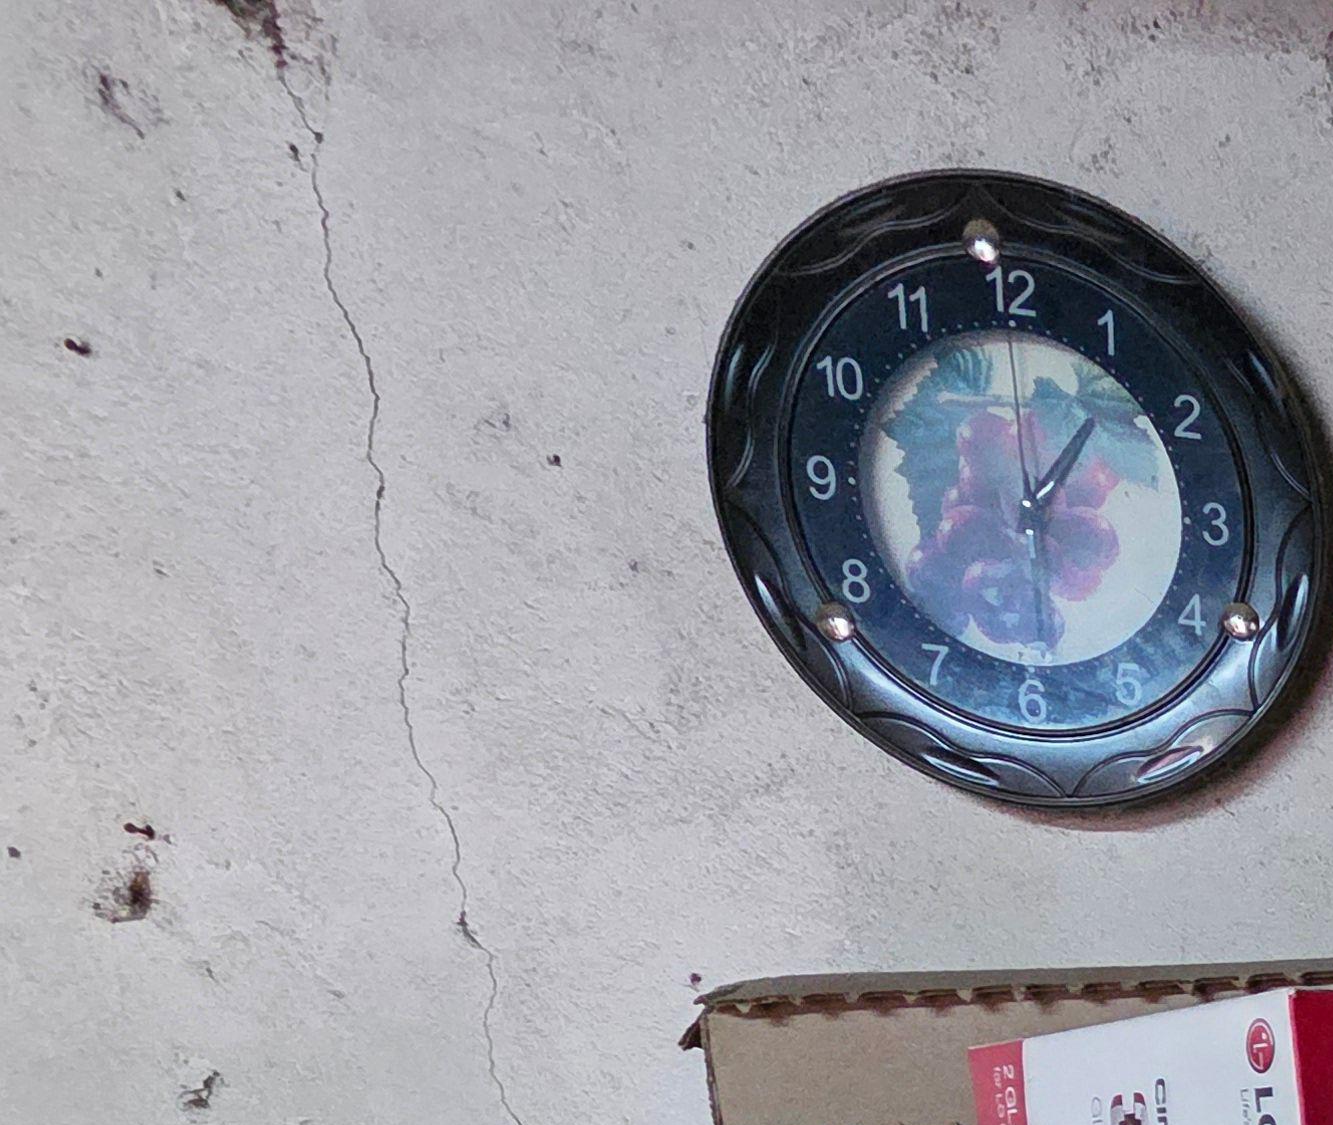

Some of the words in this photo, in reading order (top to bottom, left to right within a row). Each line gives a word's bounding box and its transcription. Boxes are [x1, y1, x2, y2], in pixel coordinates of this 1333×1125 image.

[888, 283, 929, 333] 11
[986, 266, 1037, 318] 12
[1097, 310, 1116, 355] 1
[816, 355, 864, 400] 10
[1173, 395, 1202, 439] 2
[806, 455, 837, 499] 9
[1202, 503, 1229, 545] 3
[842, 559, 870, 603] 8
[1177, 594, 1205, 635] 4
[920, 643, 949, 686] 7
[1114, 663, 1142, 704] 5
[1018, 678, 1046, 722] 6
[1002, 1064, 1015, 1079] 2
